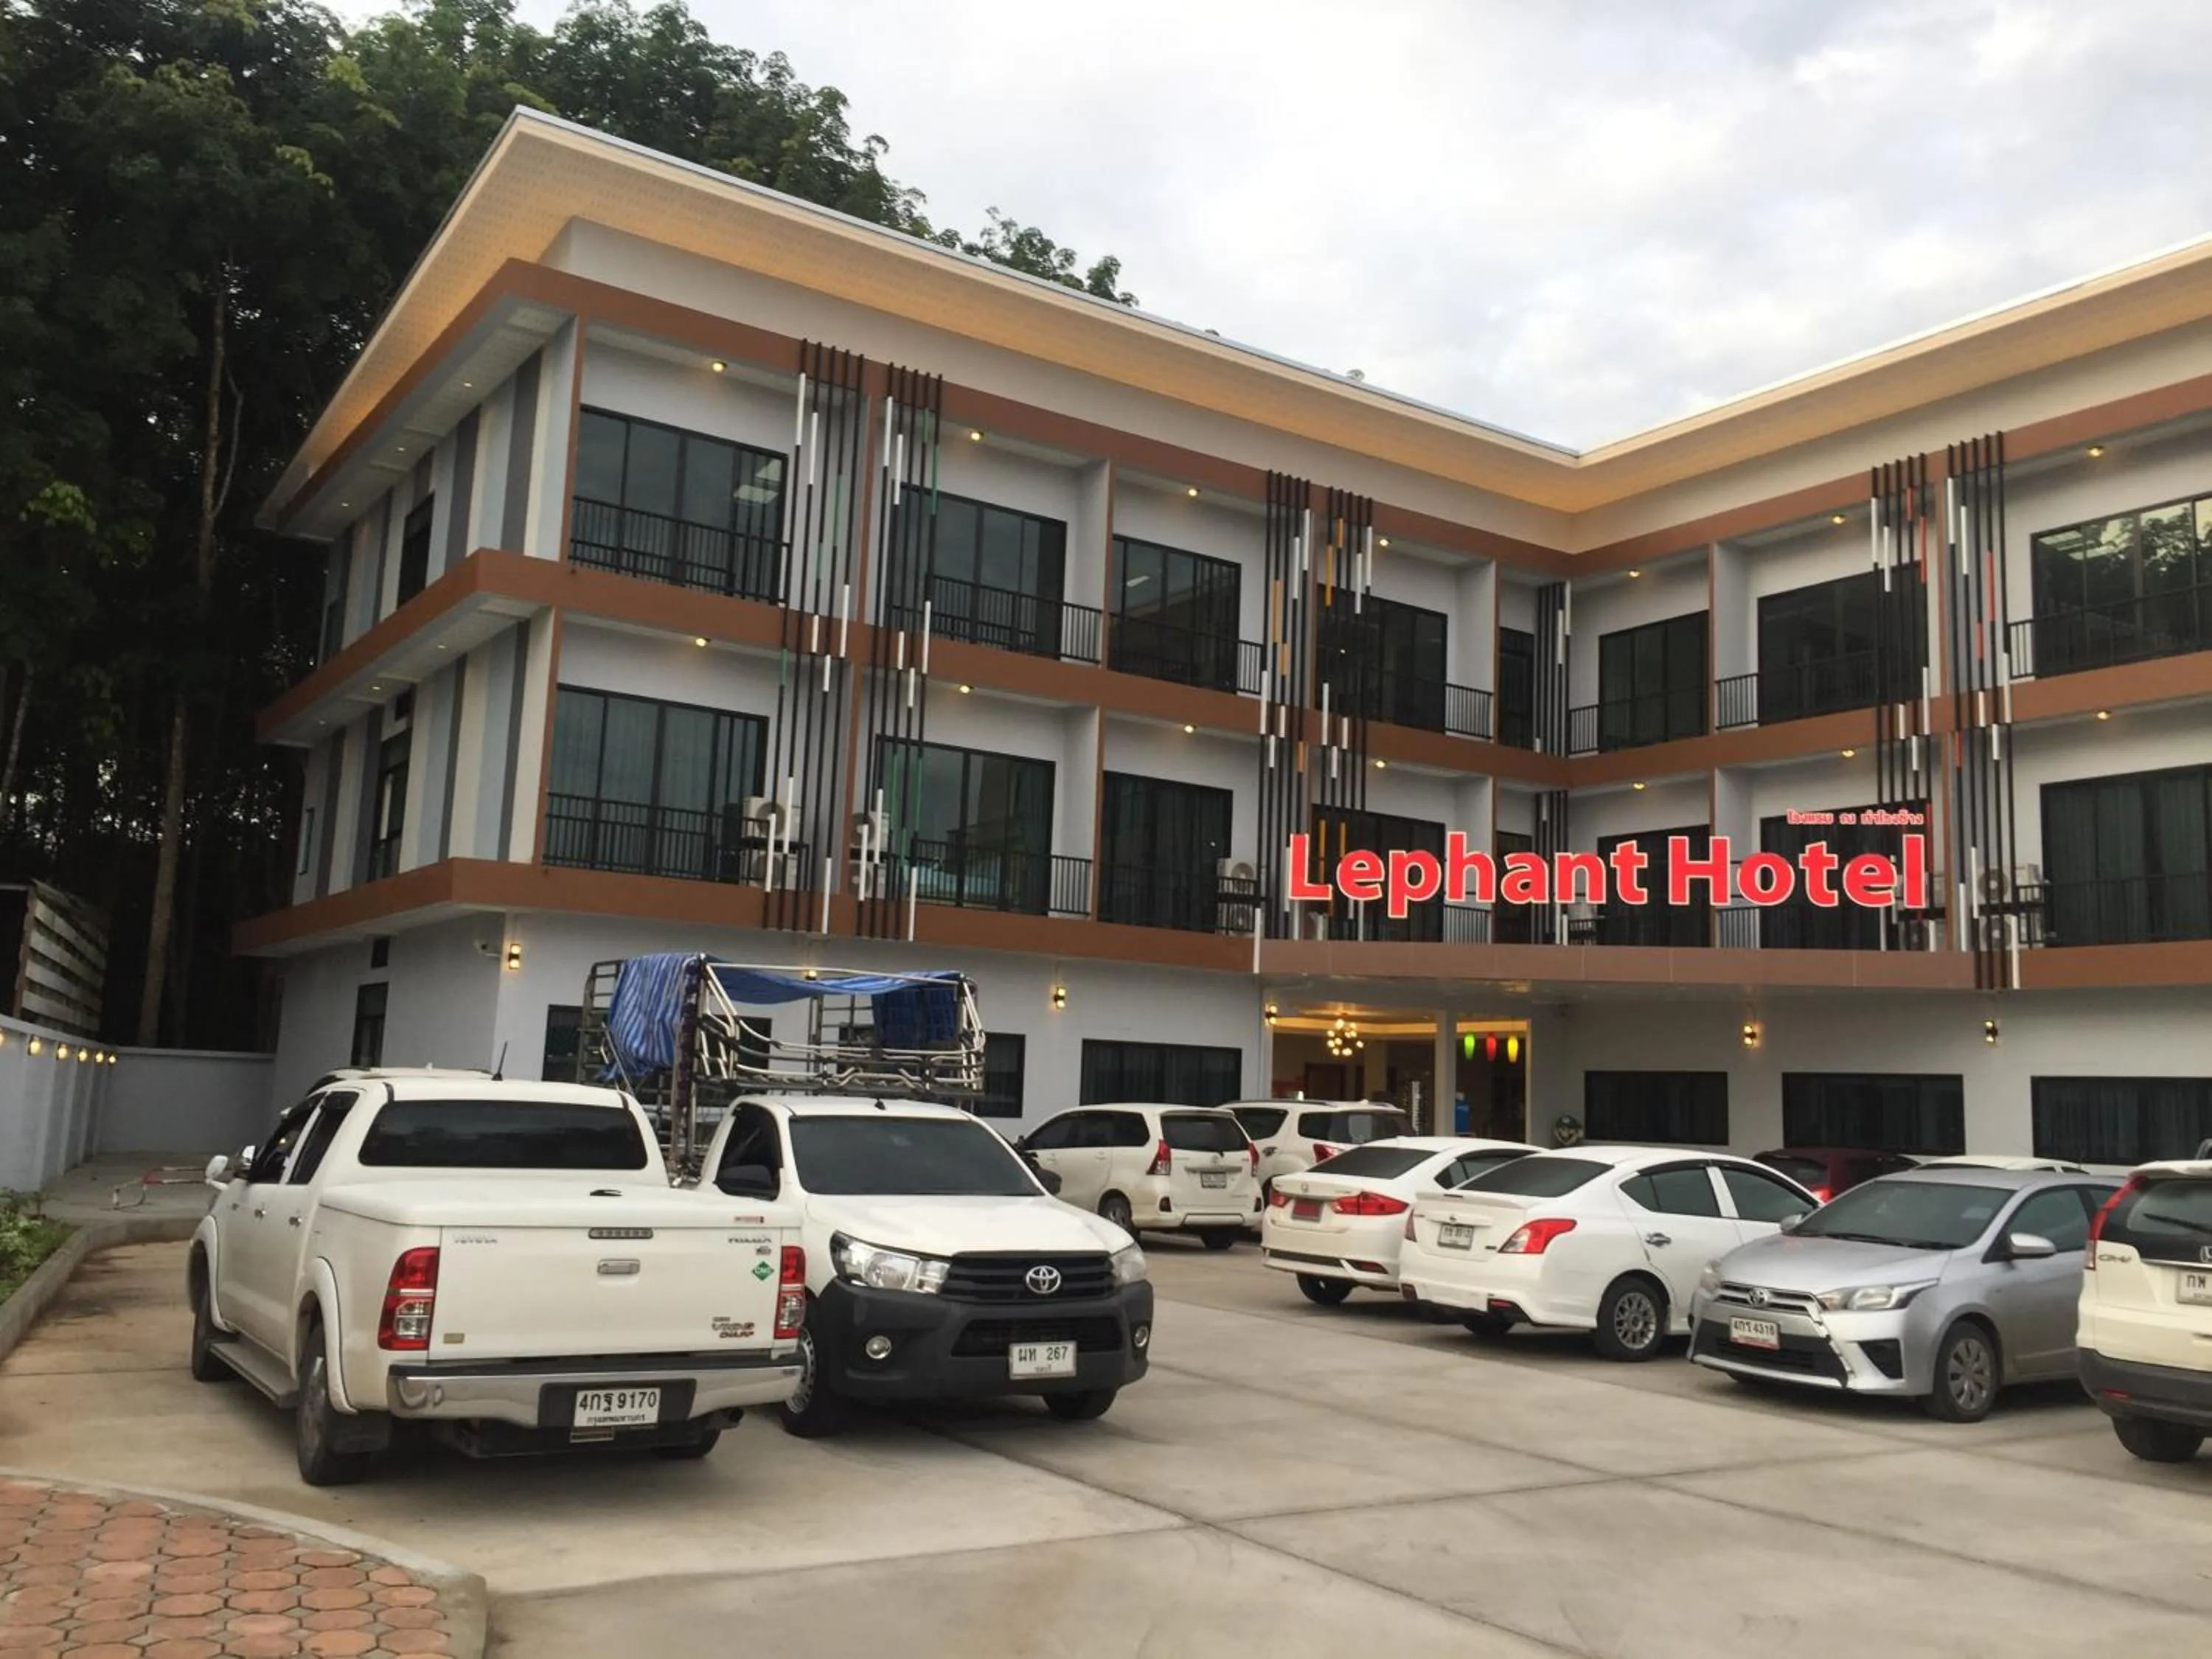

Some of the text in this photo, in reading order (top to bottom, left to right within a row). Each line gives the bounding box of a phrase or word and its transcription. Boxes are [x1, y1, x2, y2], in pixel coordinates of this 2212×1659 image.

[1287, 830, 1927, 919] Lephant Hotel
[1046, 1346, 1068, 1361] 267
[617, 1391, 657, 1409] 9170
